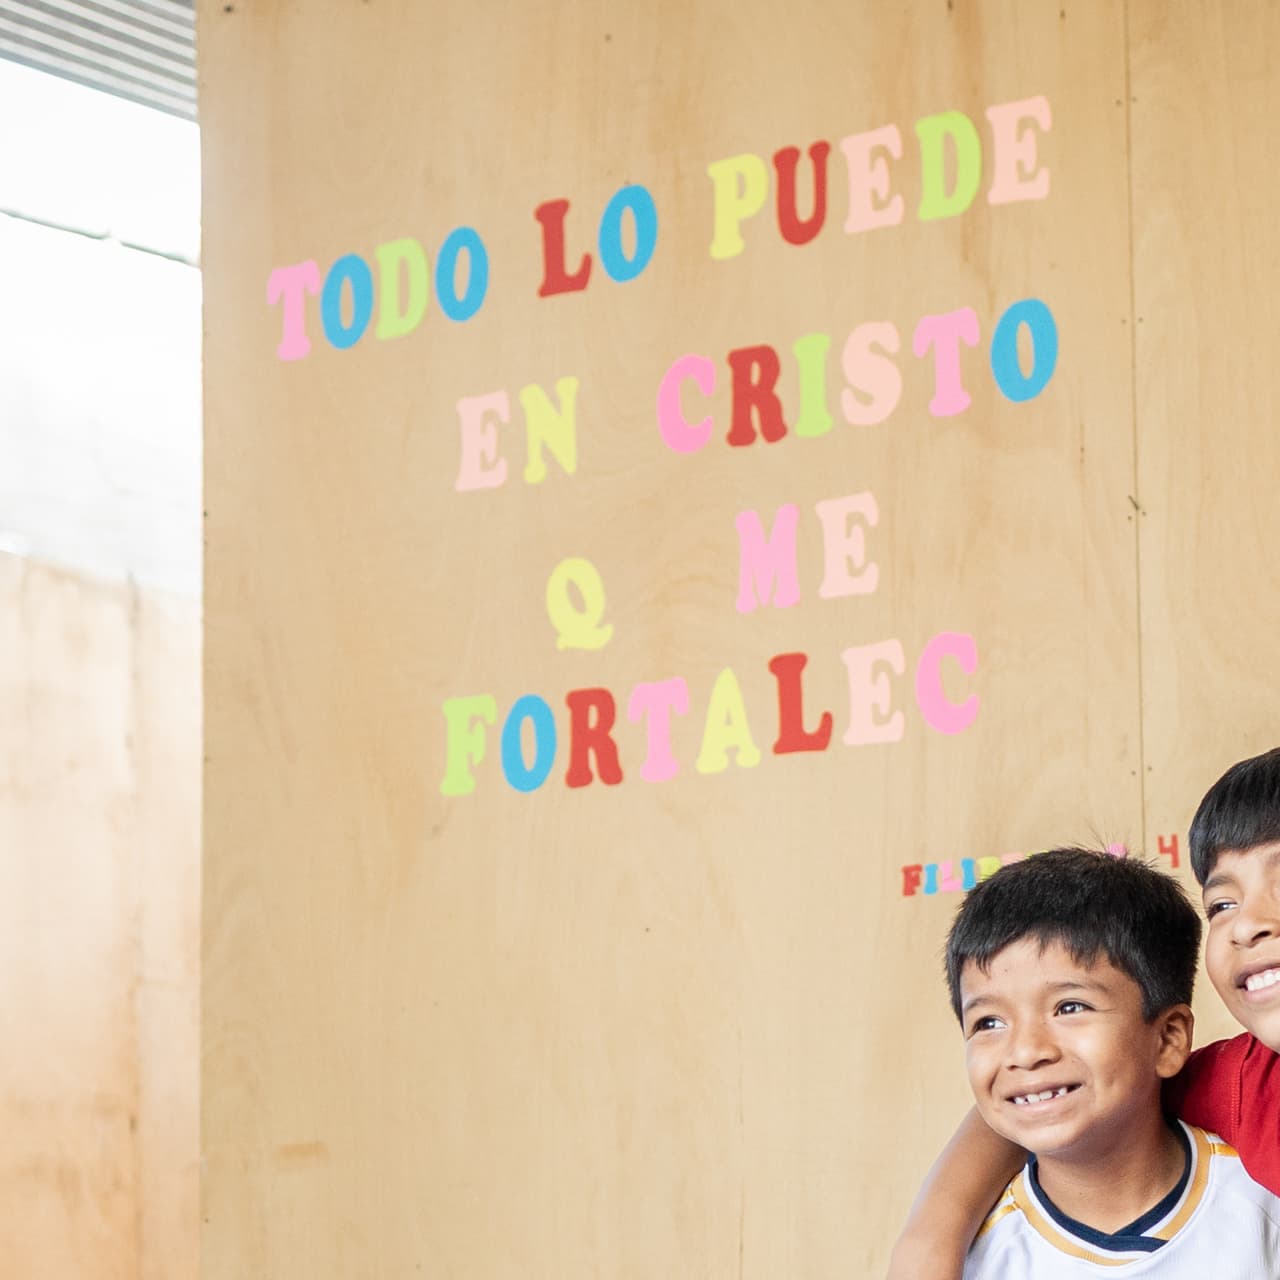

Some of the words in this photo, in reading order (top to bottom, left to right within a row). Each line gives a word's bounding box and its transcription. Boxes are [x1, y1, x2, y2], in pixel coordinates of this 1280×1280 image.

[266, 226, 489, 361] TODO
[533, 184, 658, 298] LO
[707, 95, 1052, 260] PUEDE
[454, 376, 579, 492] EN
[657, 298, 1059, 453] CRISTO
[546, 557, 613, 650] Q
[735, 491, 880, 614] ME
[440, 631, 980, 797] FORTALEC
